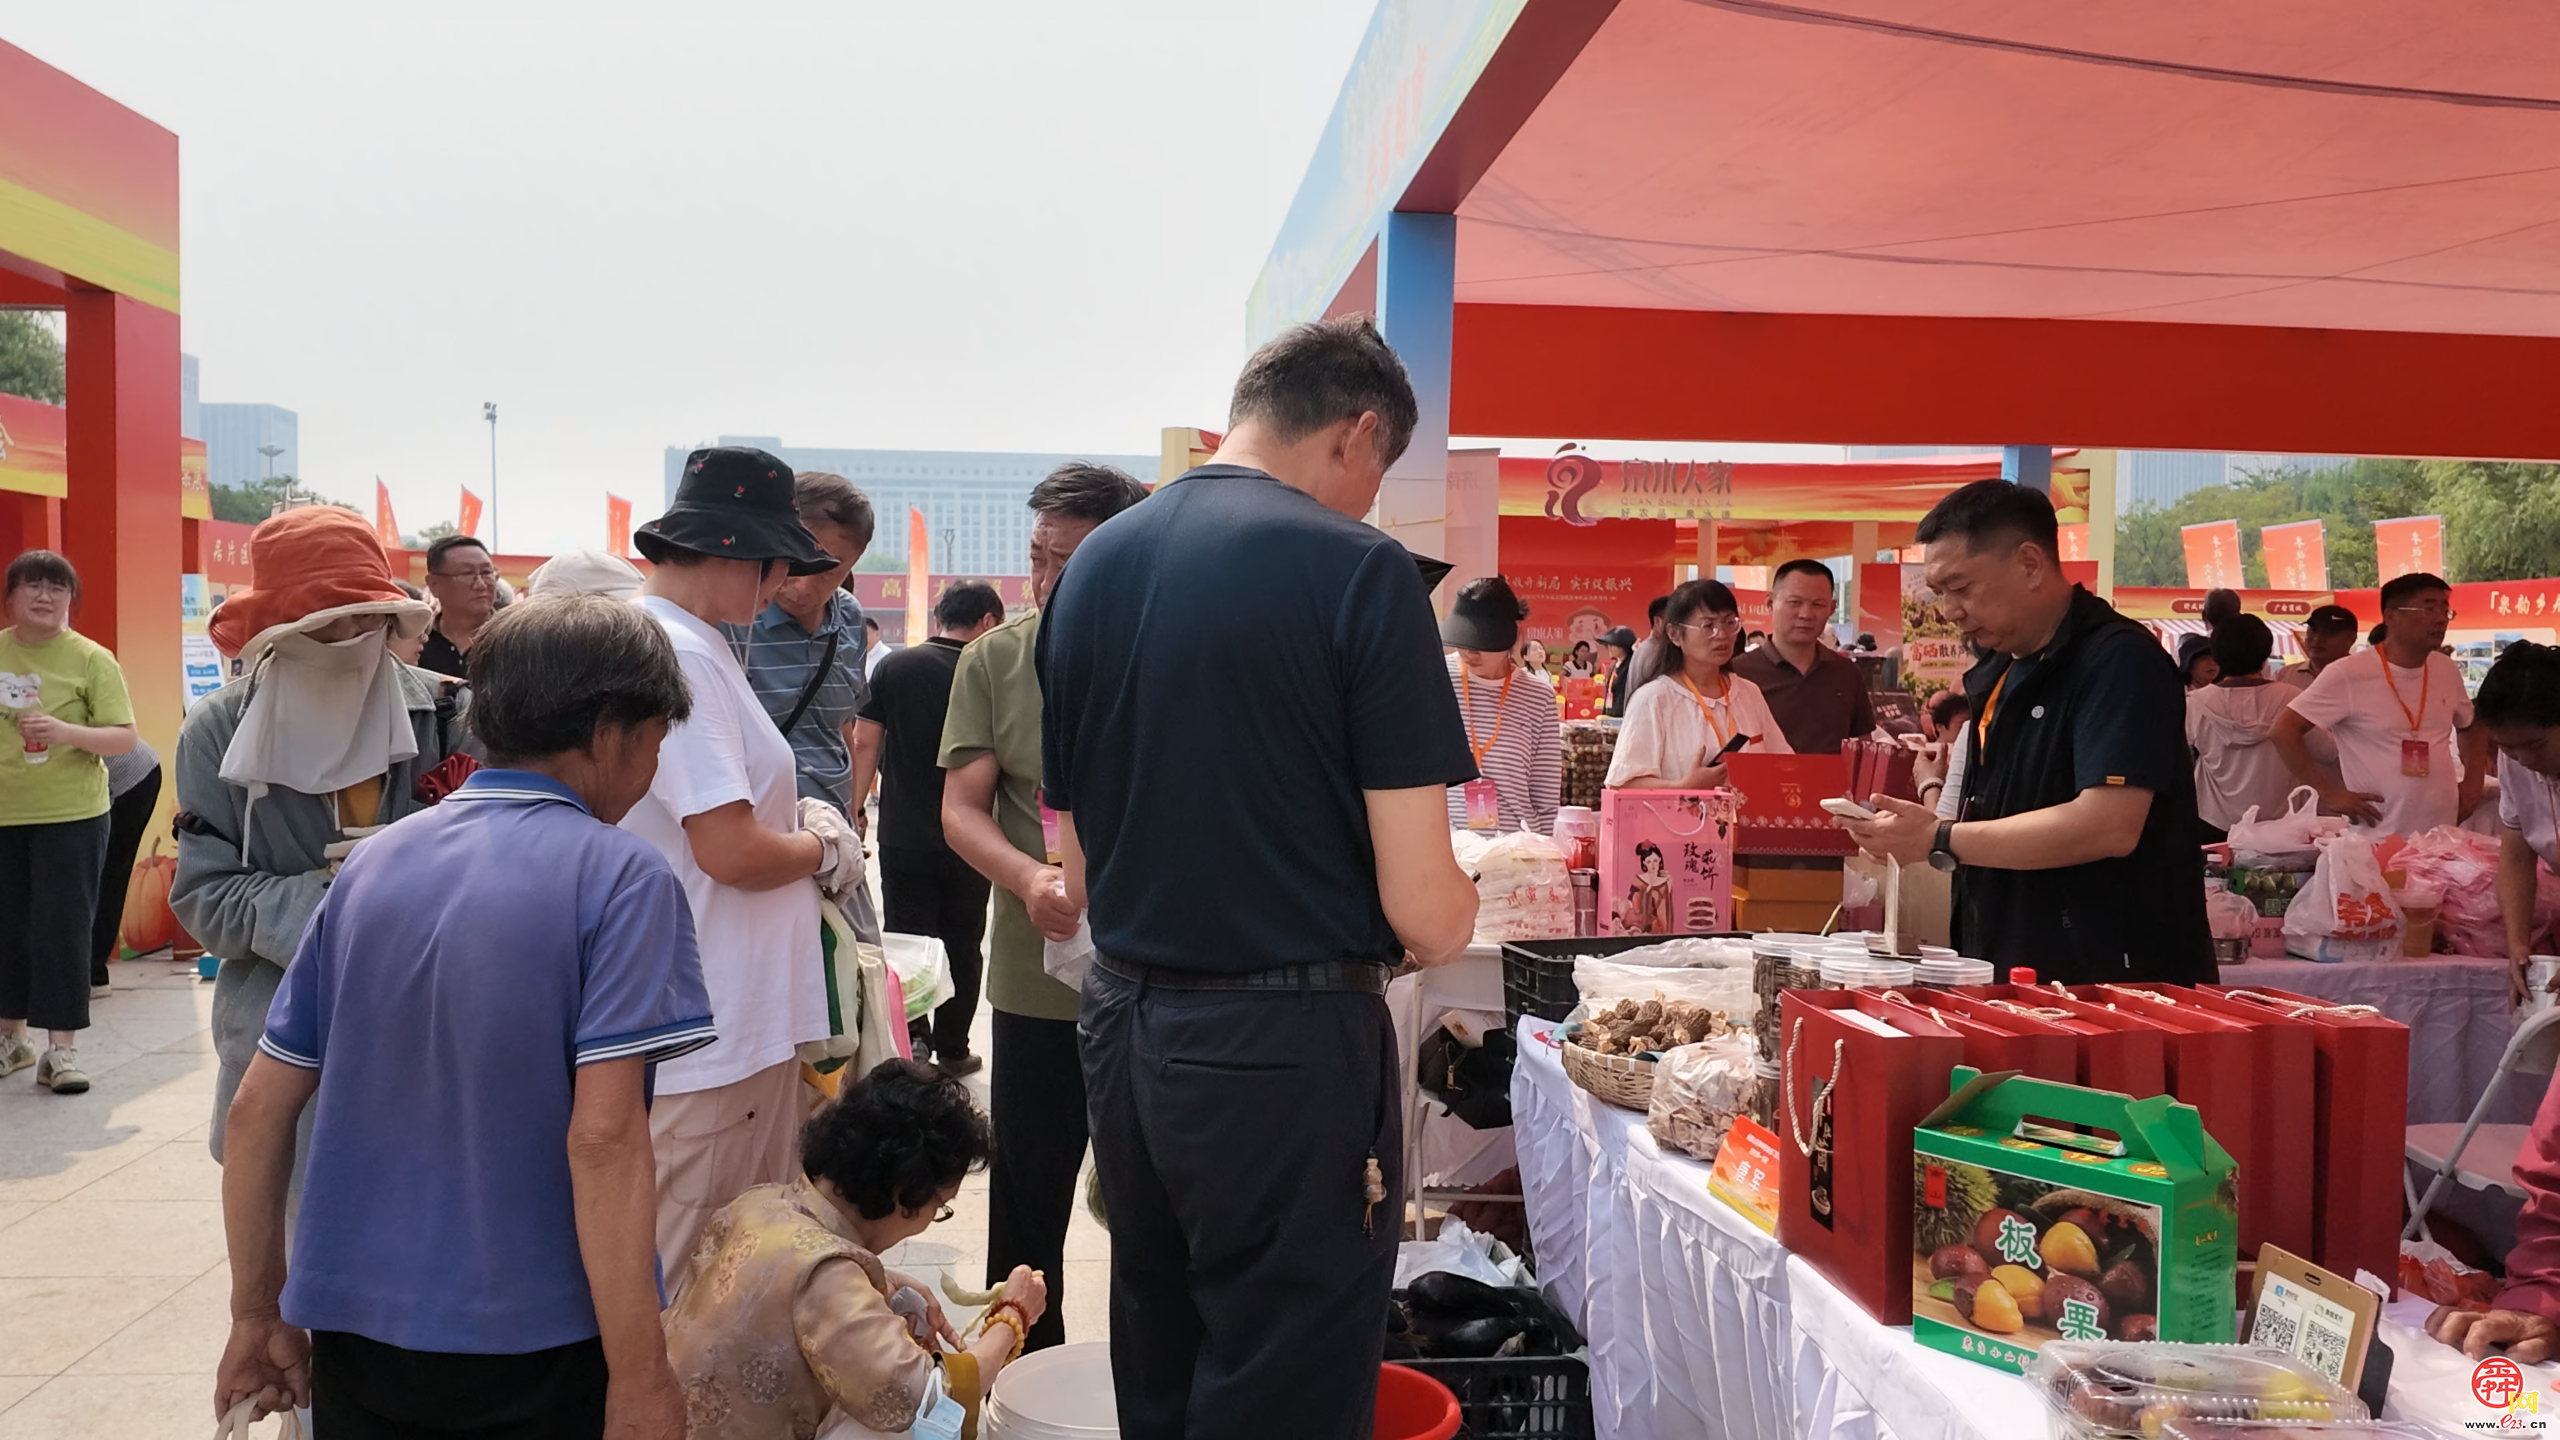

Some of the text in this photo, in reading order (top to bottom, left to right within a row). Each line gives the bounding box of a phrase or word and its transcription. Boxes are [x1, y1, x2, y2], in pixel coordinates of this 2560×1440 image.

[1620, 497, 1651, 507] QUAN
[1683, 841, 1701, 873] 玫瑰
[1701, 848, 1718, 891] 花饼
[1996, 1214, 2108, 1342] 板 栗
